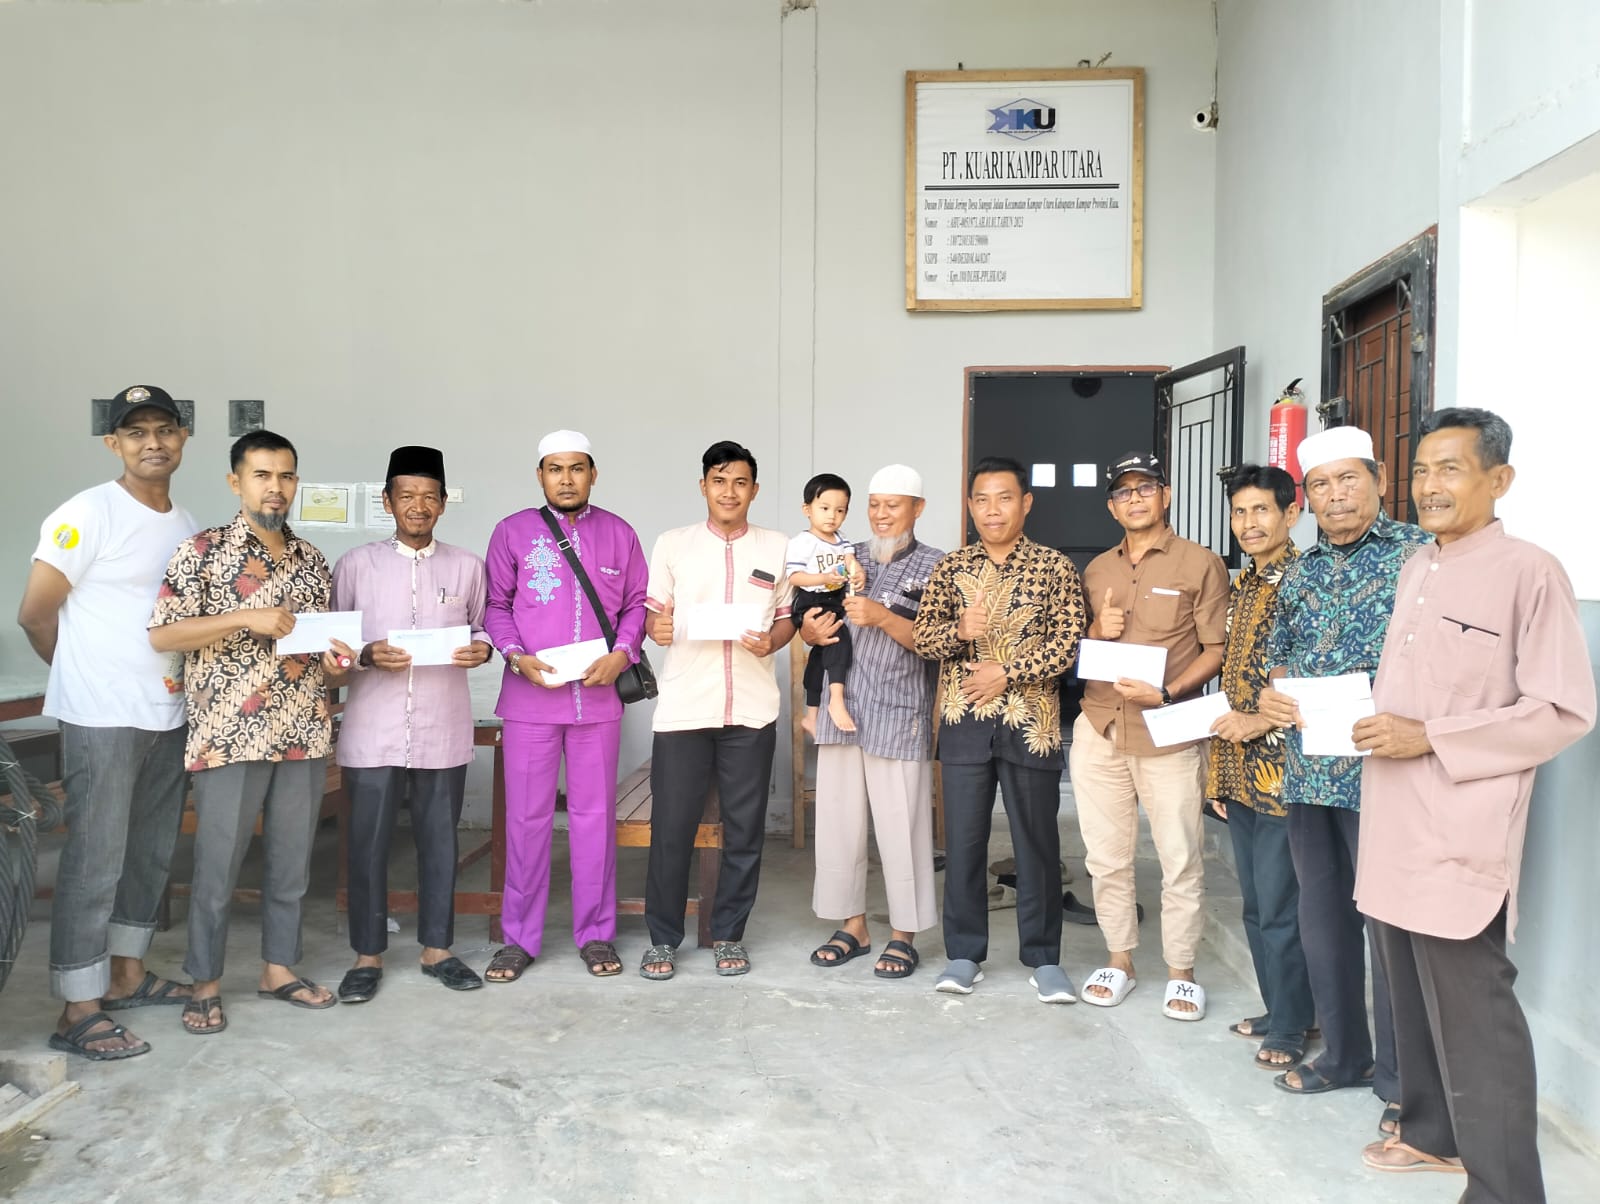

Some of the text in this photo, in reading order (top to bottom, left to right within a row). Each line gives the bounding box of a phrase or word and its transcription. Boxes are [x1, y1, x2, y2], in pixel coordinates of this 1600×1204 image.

[965, 151, 1004, 180] KUARI
[1006, 150, 1059, 179] KAMPAR
[1062, 149, 1103, 178] UTARA
[1004, 198, 1026, 210] Kecamatan
[1027, 198, 1042, 212] Kampar
[1042, 198, 1055, 210] Utara
[1055, 197, 1075, 212] Kabupaten
[1075, 197, 1092, 212] Kampar
[1278, 434, 1287, 459] POWDER
